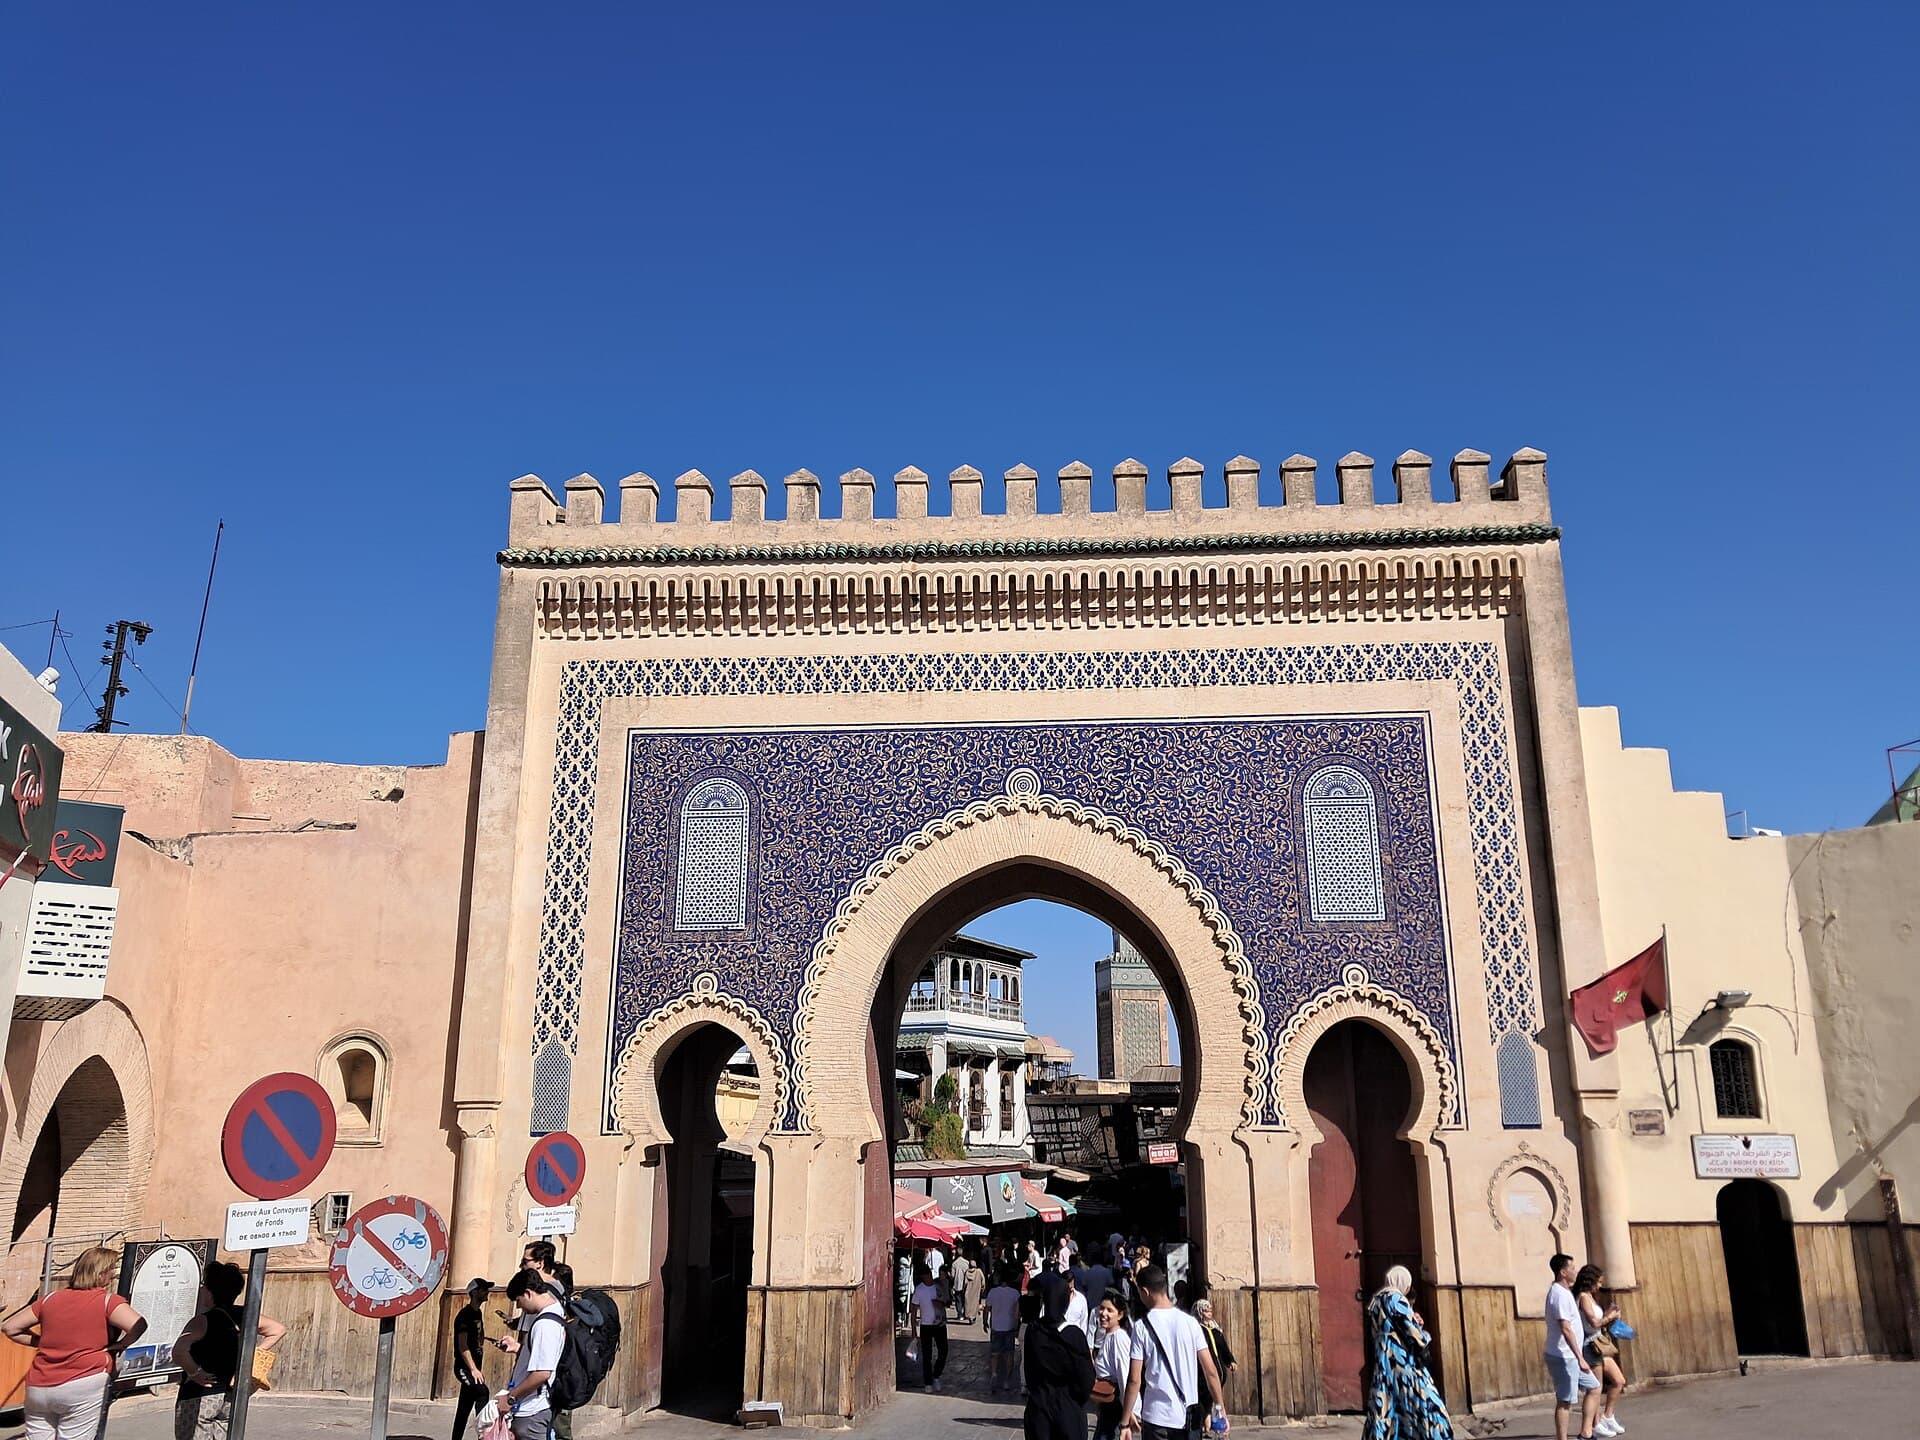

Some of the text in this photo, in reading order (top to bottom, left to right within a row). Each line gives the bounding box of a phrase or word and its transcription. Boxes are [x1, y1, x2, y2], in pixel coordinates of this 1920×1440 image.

[259, 1208, 271, 1216] Aux
[272, 1206, 308, 1216] Convoyeurs
[265, 1218, 284, 1227] Fonds
